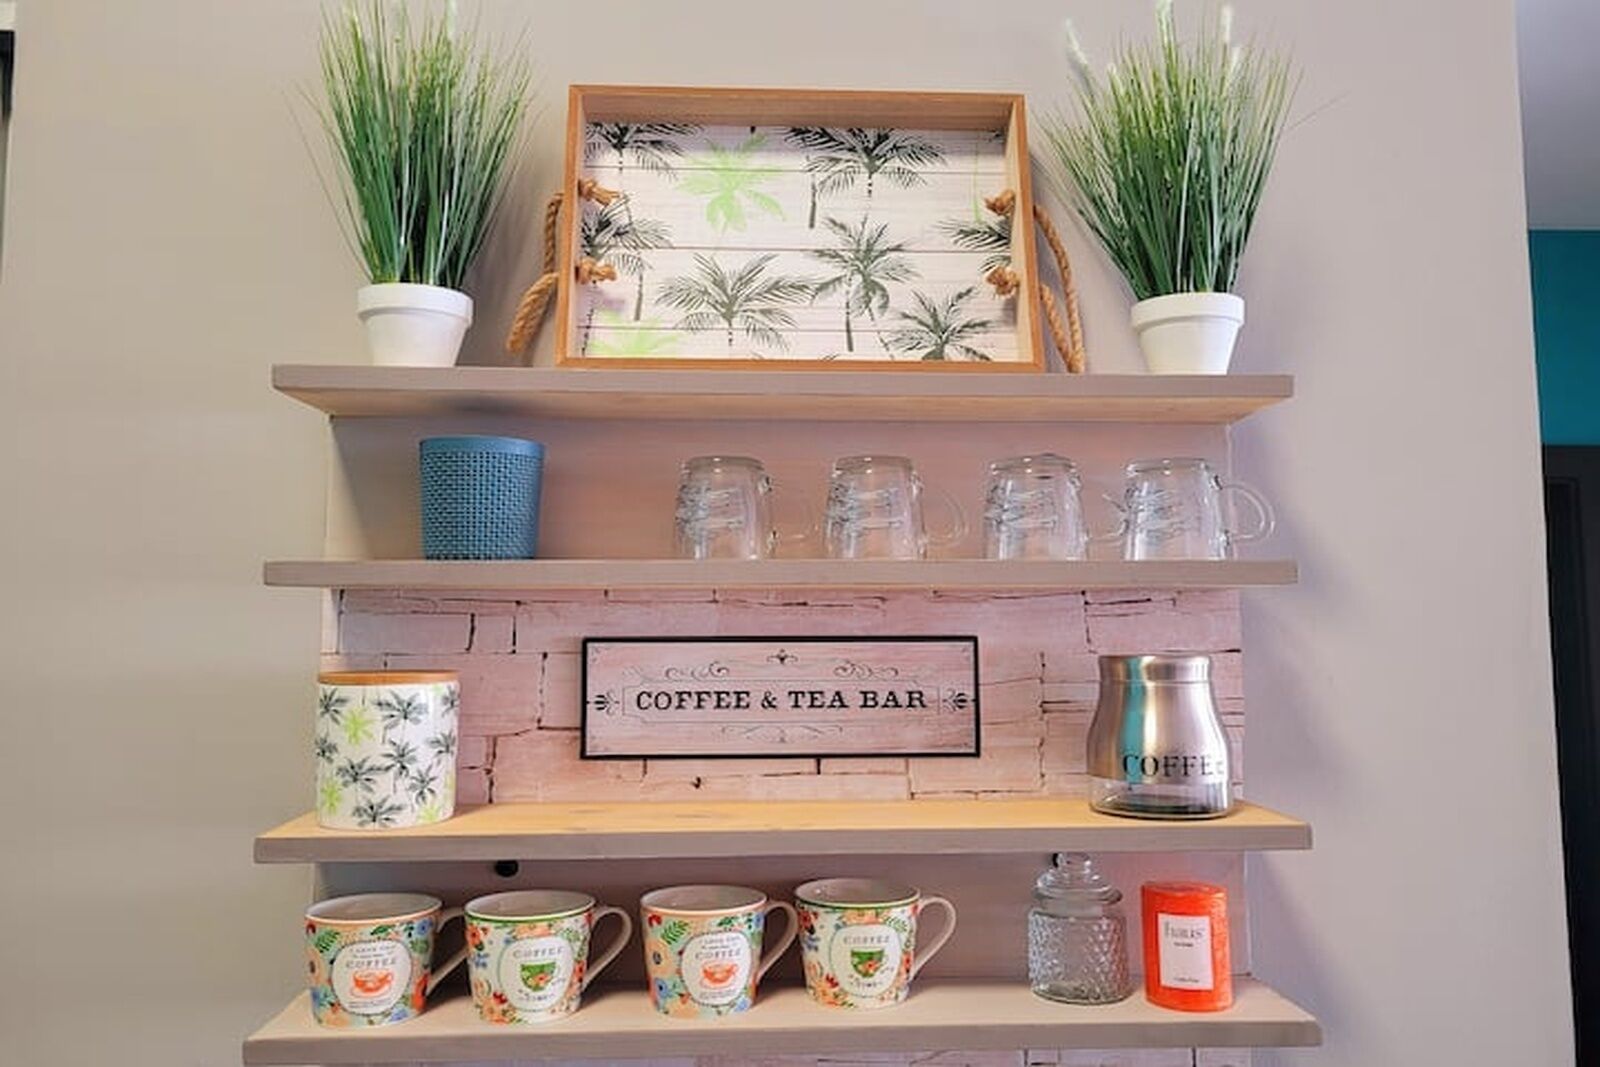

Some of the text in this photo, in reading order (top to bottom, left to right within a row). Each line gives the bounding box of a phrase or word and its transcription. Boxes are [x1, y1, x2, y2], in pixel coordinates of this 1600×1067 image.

[636, 689, 928, 711] COFFEE & TEA BAR
[513, 946, 564, 958] COFFEE
